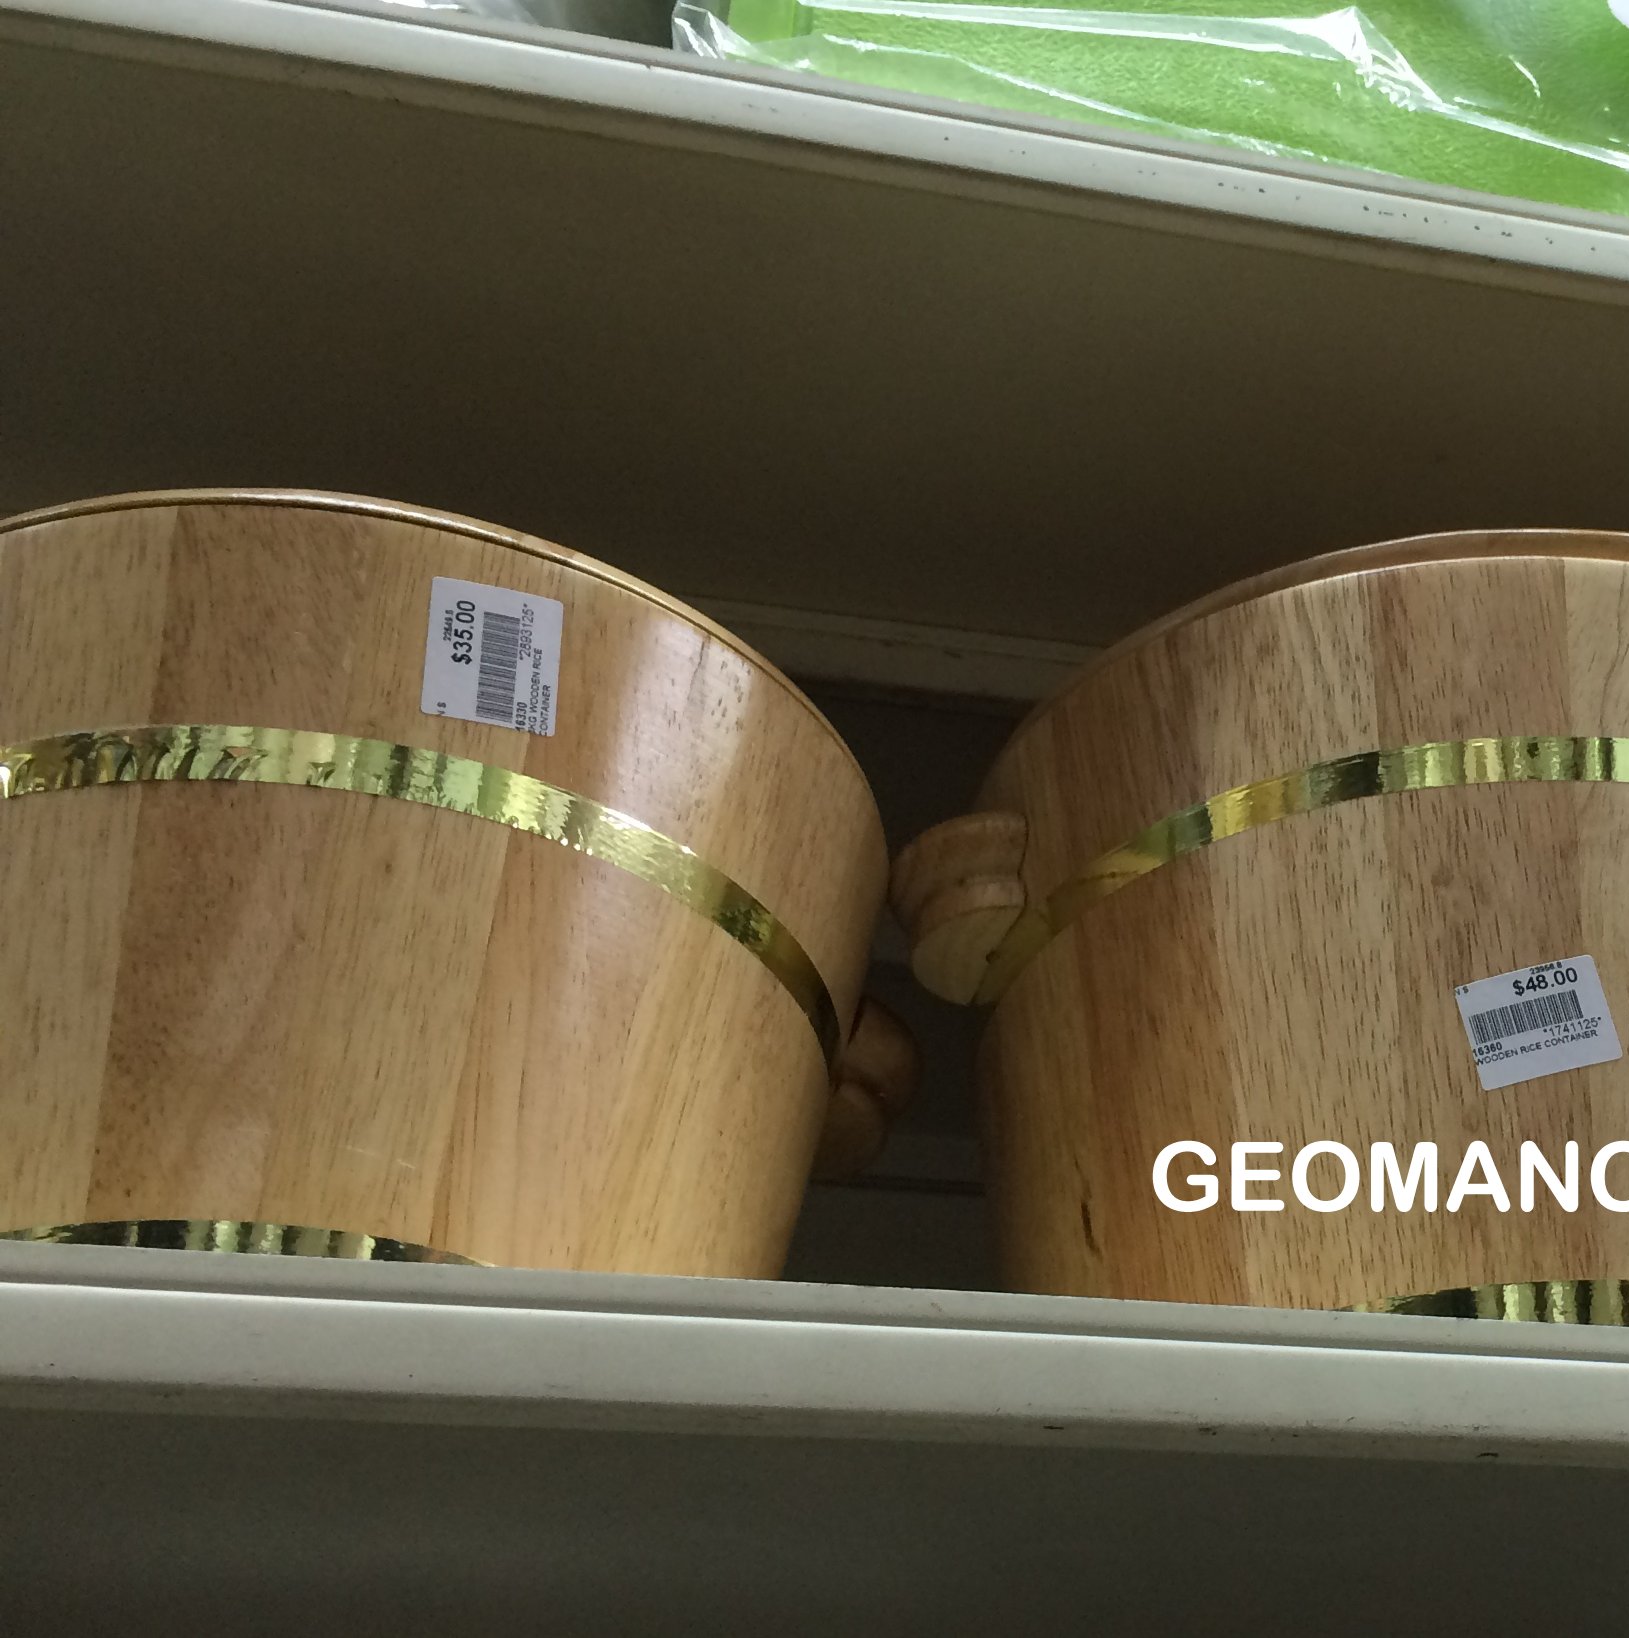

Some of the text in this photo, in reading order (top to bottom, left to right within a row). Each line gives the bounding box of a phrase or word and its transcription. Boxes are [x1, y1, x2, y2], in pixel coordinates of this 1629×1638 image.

[450, 600, 476, 665] $35.00
[533, 648, 543, 671] RICE
[530, 672, 541, 714] WOODEN
[539, 684, 551, 736] CONTAINER
[1512, 967, 1578, 997] $48.00
[1475, 1029, 1598, 1066] WOODEN RICE CONTAINER
